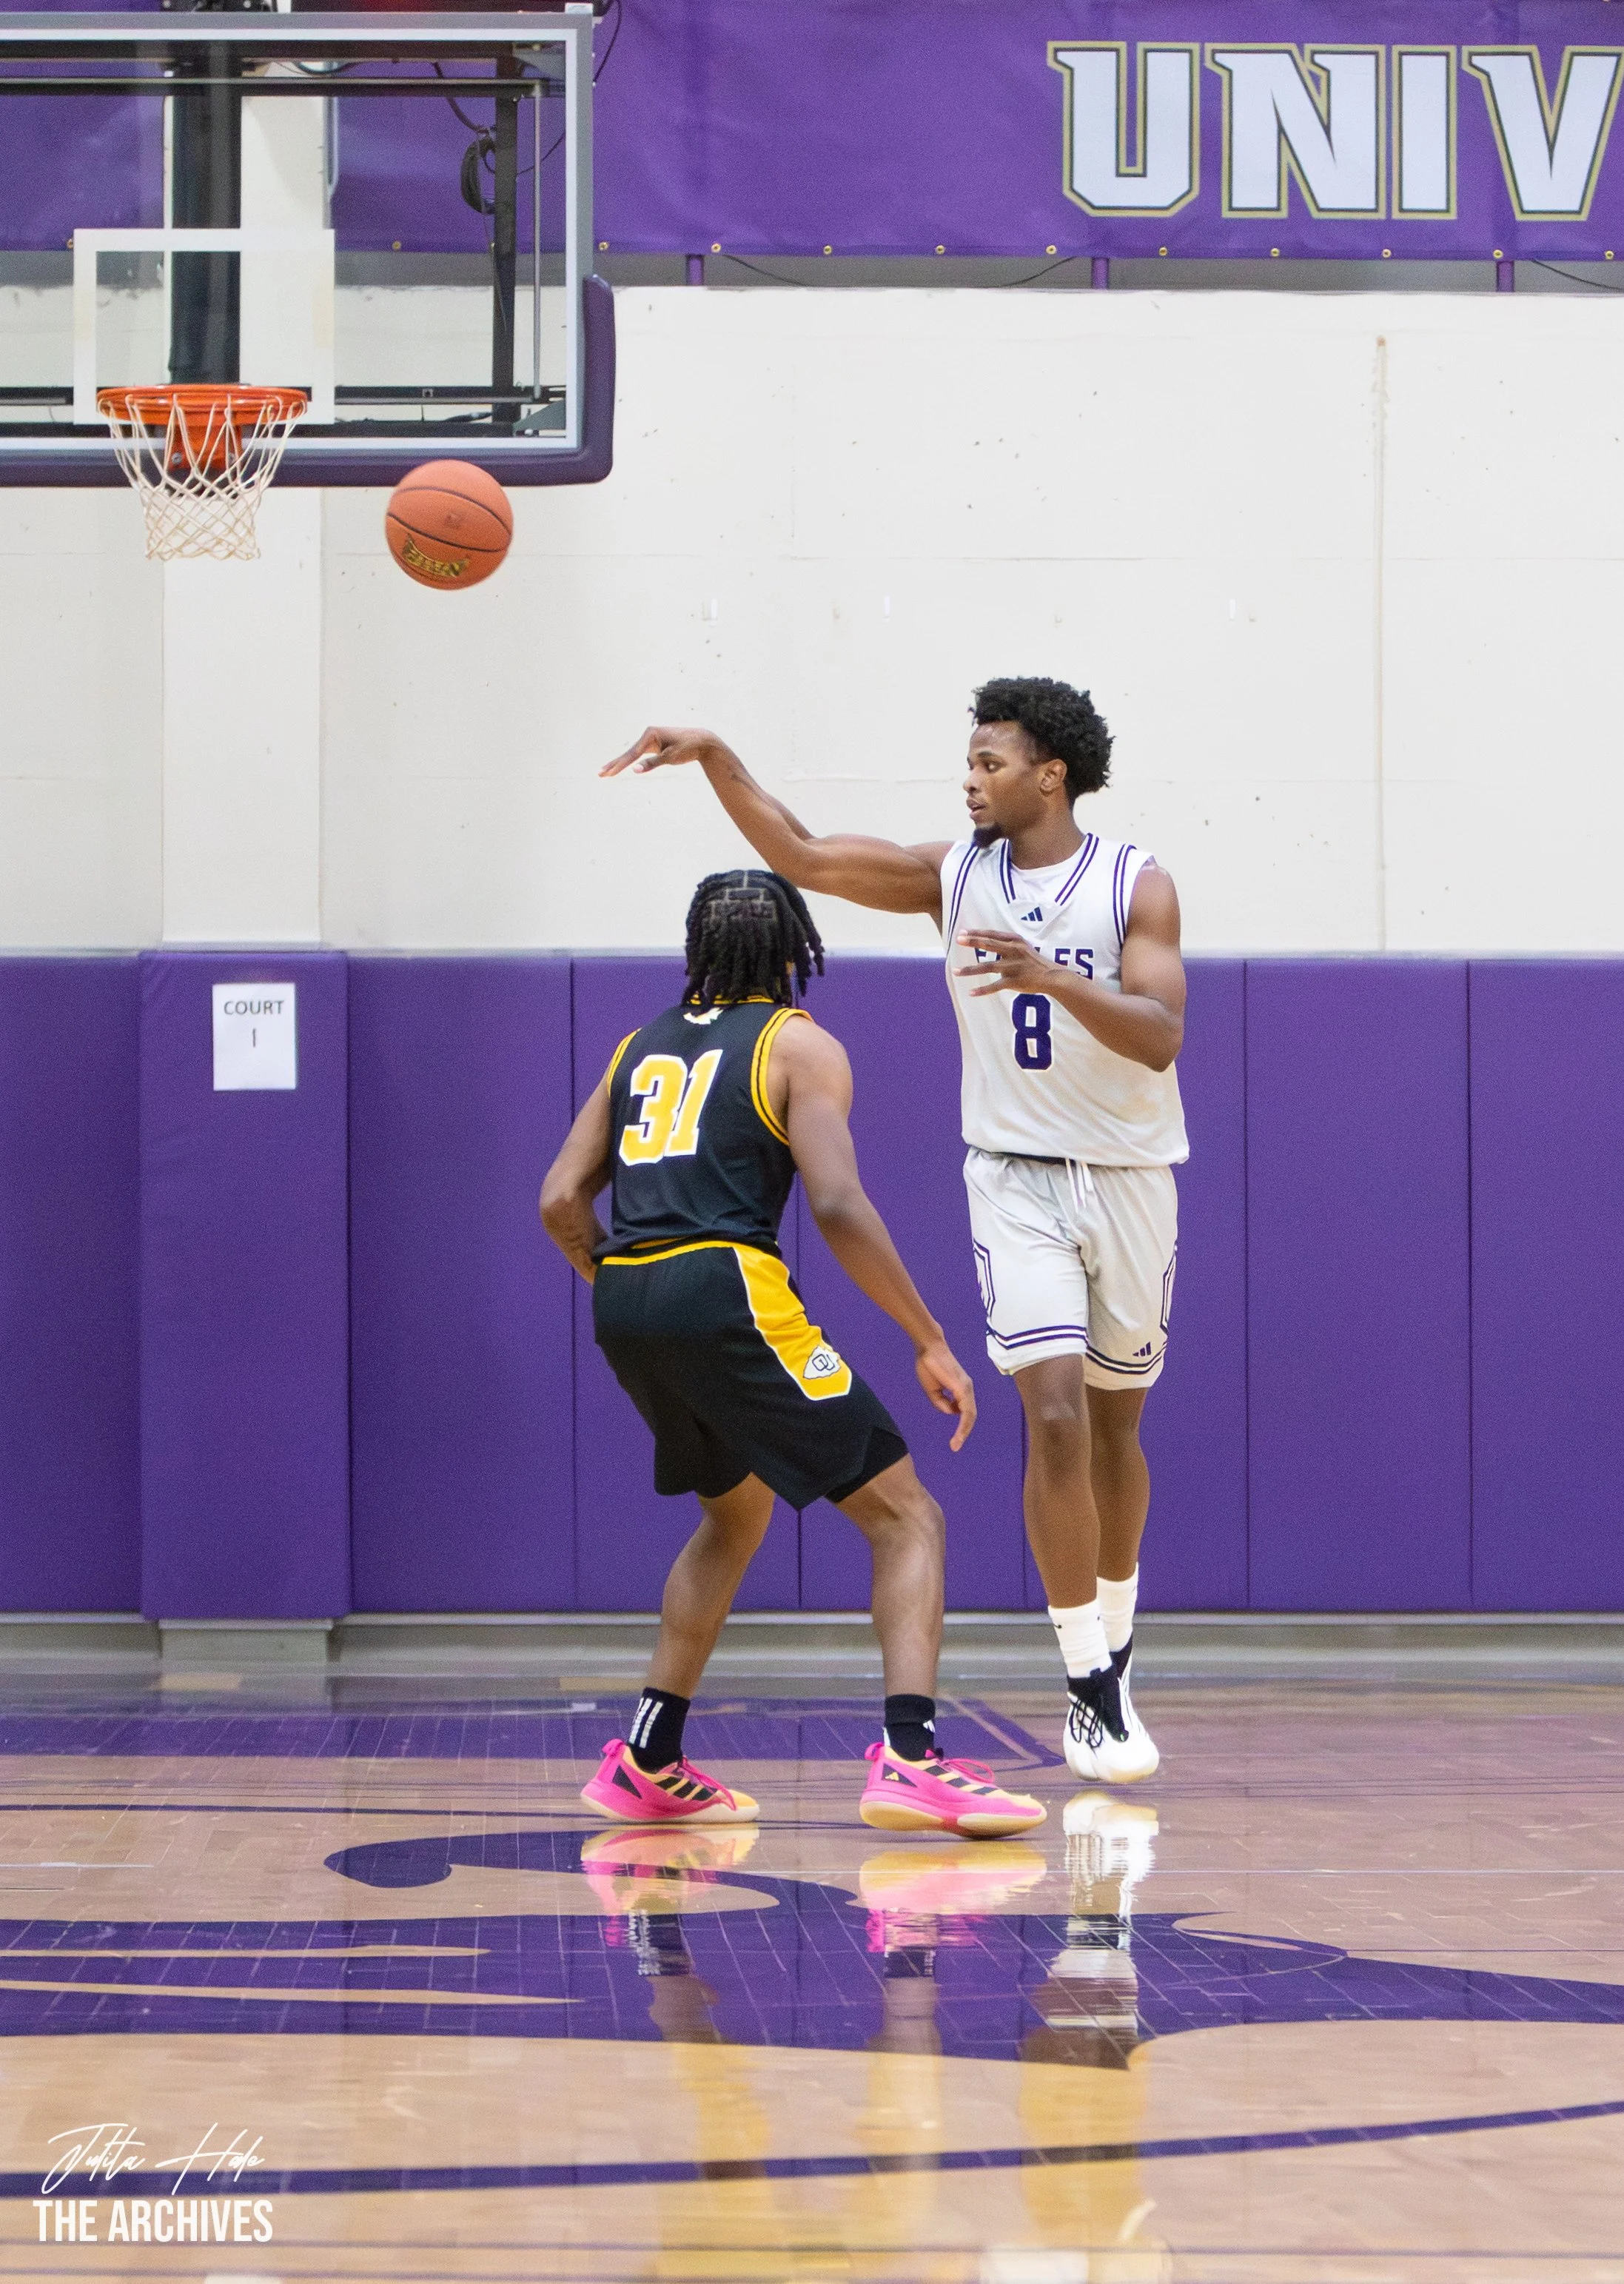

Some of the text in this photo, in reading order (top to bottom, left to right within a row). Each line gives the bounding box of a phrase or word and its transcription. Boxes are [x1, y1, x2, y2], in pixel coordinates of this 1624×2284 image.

[1047, 41, 1624, 221] UNIV
[224, 1000, 284, 1015] COURT
[1012, 993, 1053, 1070] 8
[619, 1049, 723, 1166] 31
